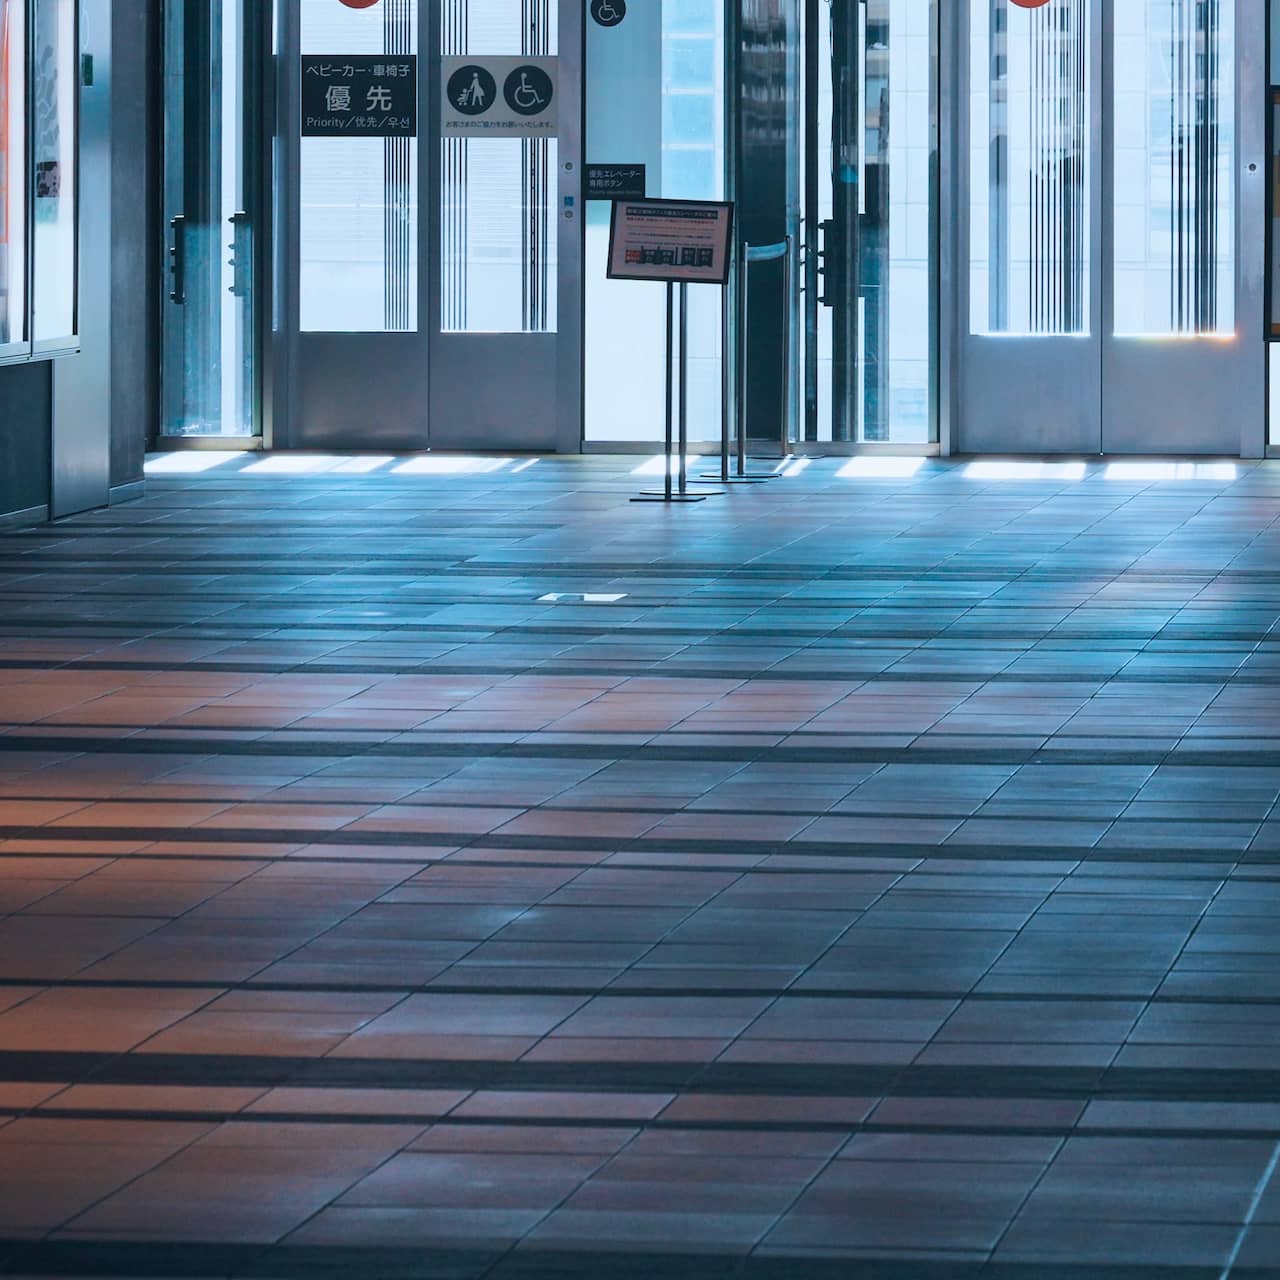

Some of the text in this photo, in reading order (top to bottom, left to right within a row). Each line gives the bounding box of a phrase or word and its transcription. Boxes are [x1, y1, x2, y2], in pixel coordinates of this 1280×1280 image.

[306, 64, 410, 77] ベビーカー・車椅子
